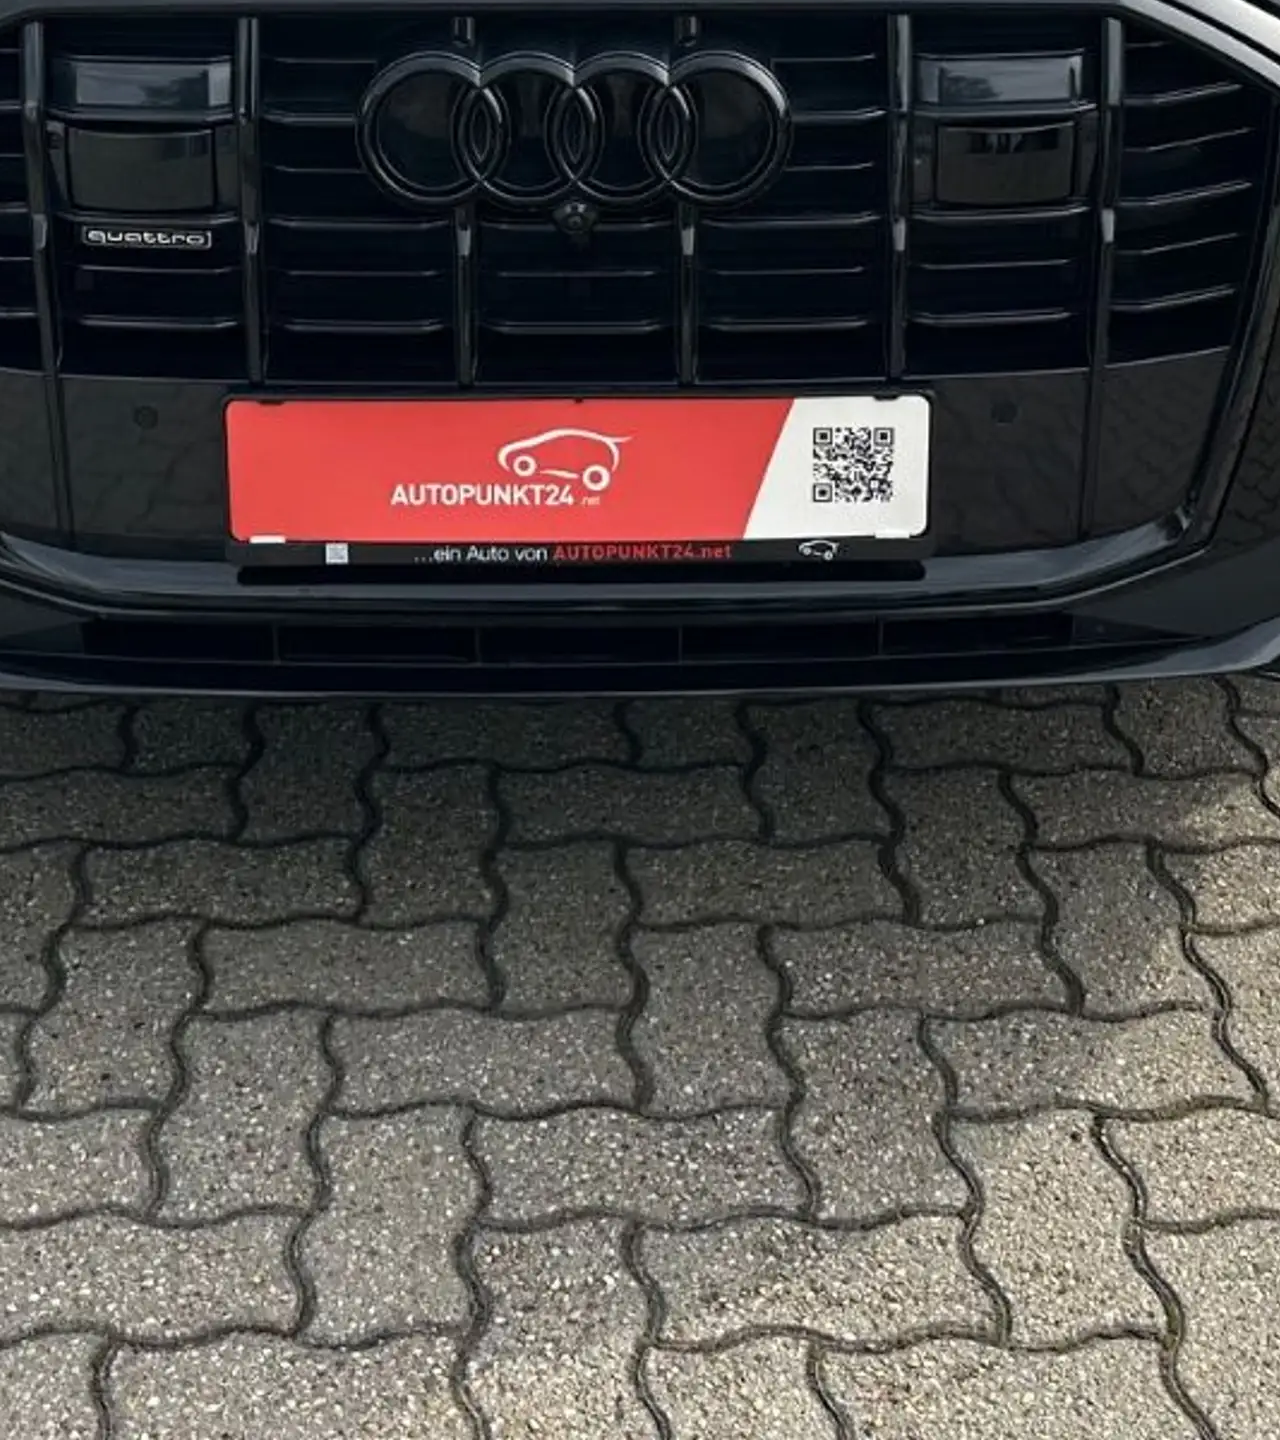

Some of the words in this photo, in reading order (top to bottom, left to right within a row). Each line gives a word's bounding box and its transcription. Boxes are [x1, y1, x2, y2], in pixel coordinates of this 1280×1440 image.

[87, 230, 205, 245] quattro
[390, 483, 574, 506] AUTOPUNKT24
[466, 545, 510, 561] Auto
[515, 548, 548, 561] von
[554, 543, 732, 560] AUTOPUNKT24.net
